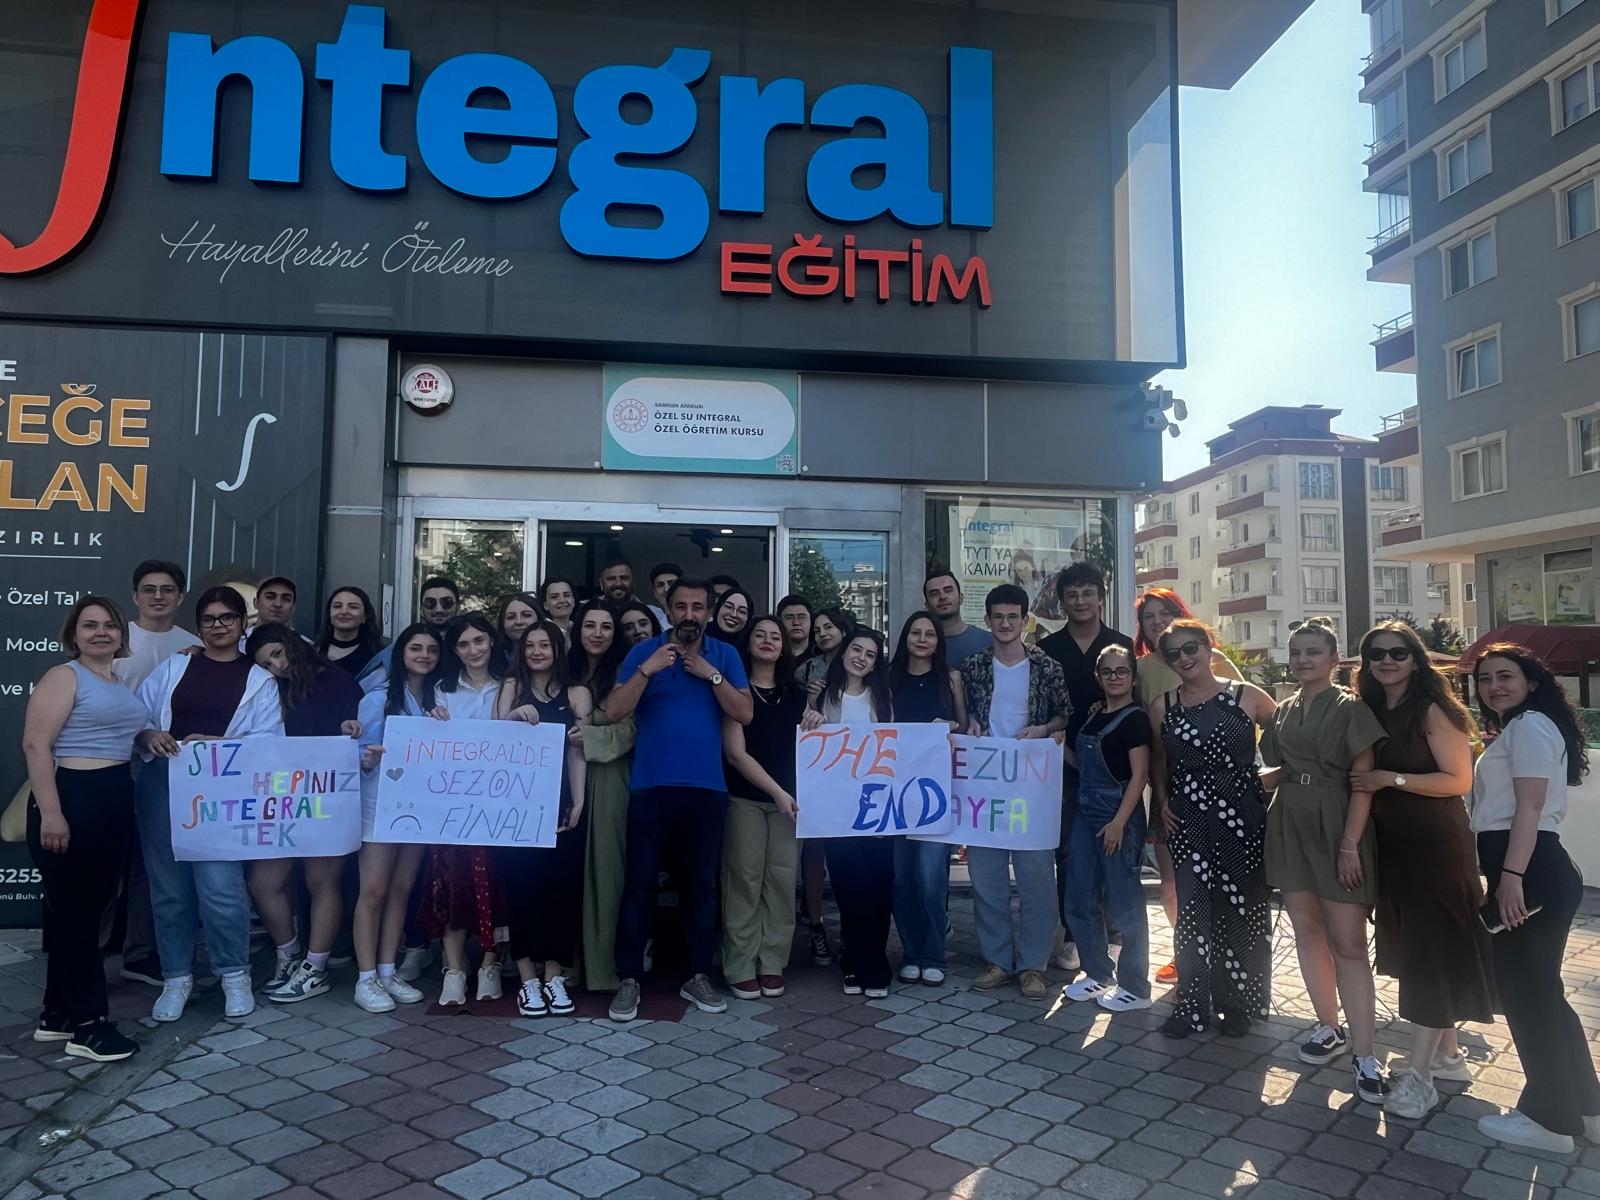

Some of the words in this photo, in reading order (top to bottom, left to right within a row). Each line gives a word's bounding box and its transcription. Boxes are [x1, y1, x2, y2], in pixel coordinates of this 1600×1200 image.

[161, 220, 370, 283] Hayallerini
[381, 221, 514, 277] Öteleme
[721, 233, 993, 309] EĞİTİM
[0, 383, 151, 448] EĞE
[654, 411, 678, 420] ÖZEL
[681, 412, 693, 421] SU
[696, 413, 742, 422] INTEGRAL
[654, 423, 679, 433] ÖZEL
[683, 423, 728, 435] ÖĞRETİM
[731, 427, 764, 436] KURSU
[964, 546, 991, 560] TYT
[7, 587, 49, 605] Özel
[0, 684, 23, 696] ve
[799, 727, 898, 780] THE
[951, 746, 1051, 784] EZUN
[427, 769, 536, 800] SEZON
[439, 803, 546, 843] FİNALİ
[851, 776, 947, 833] END
[951, 794, 1028, 834] AYFA
[232, 822, 297, 848] TEK
